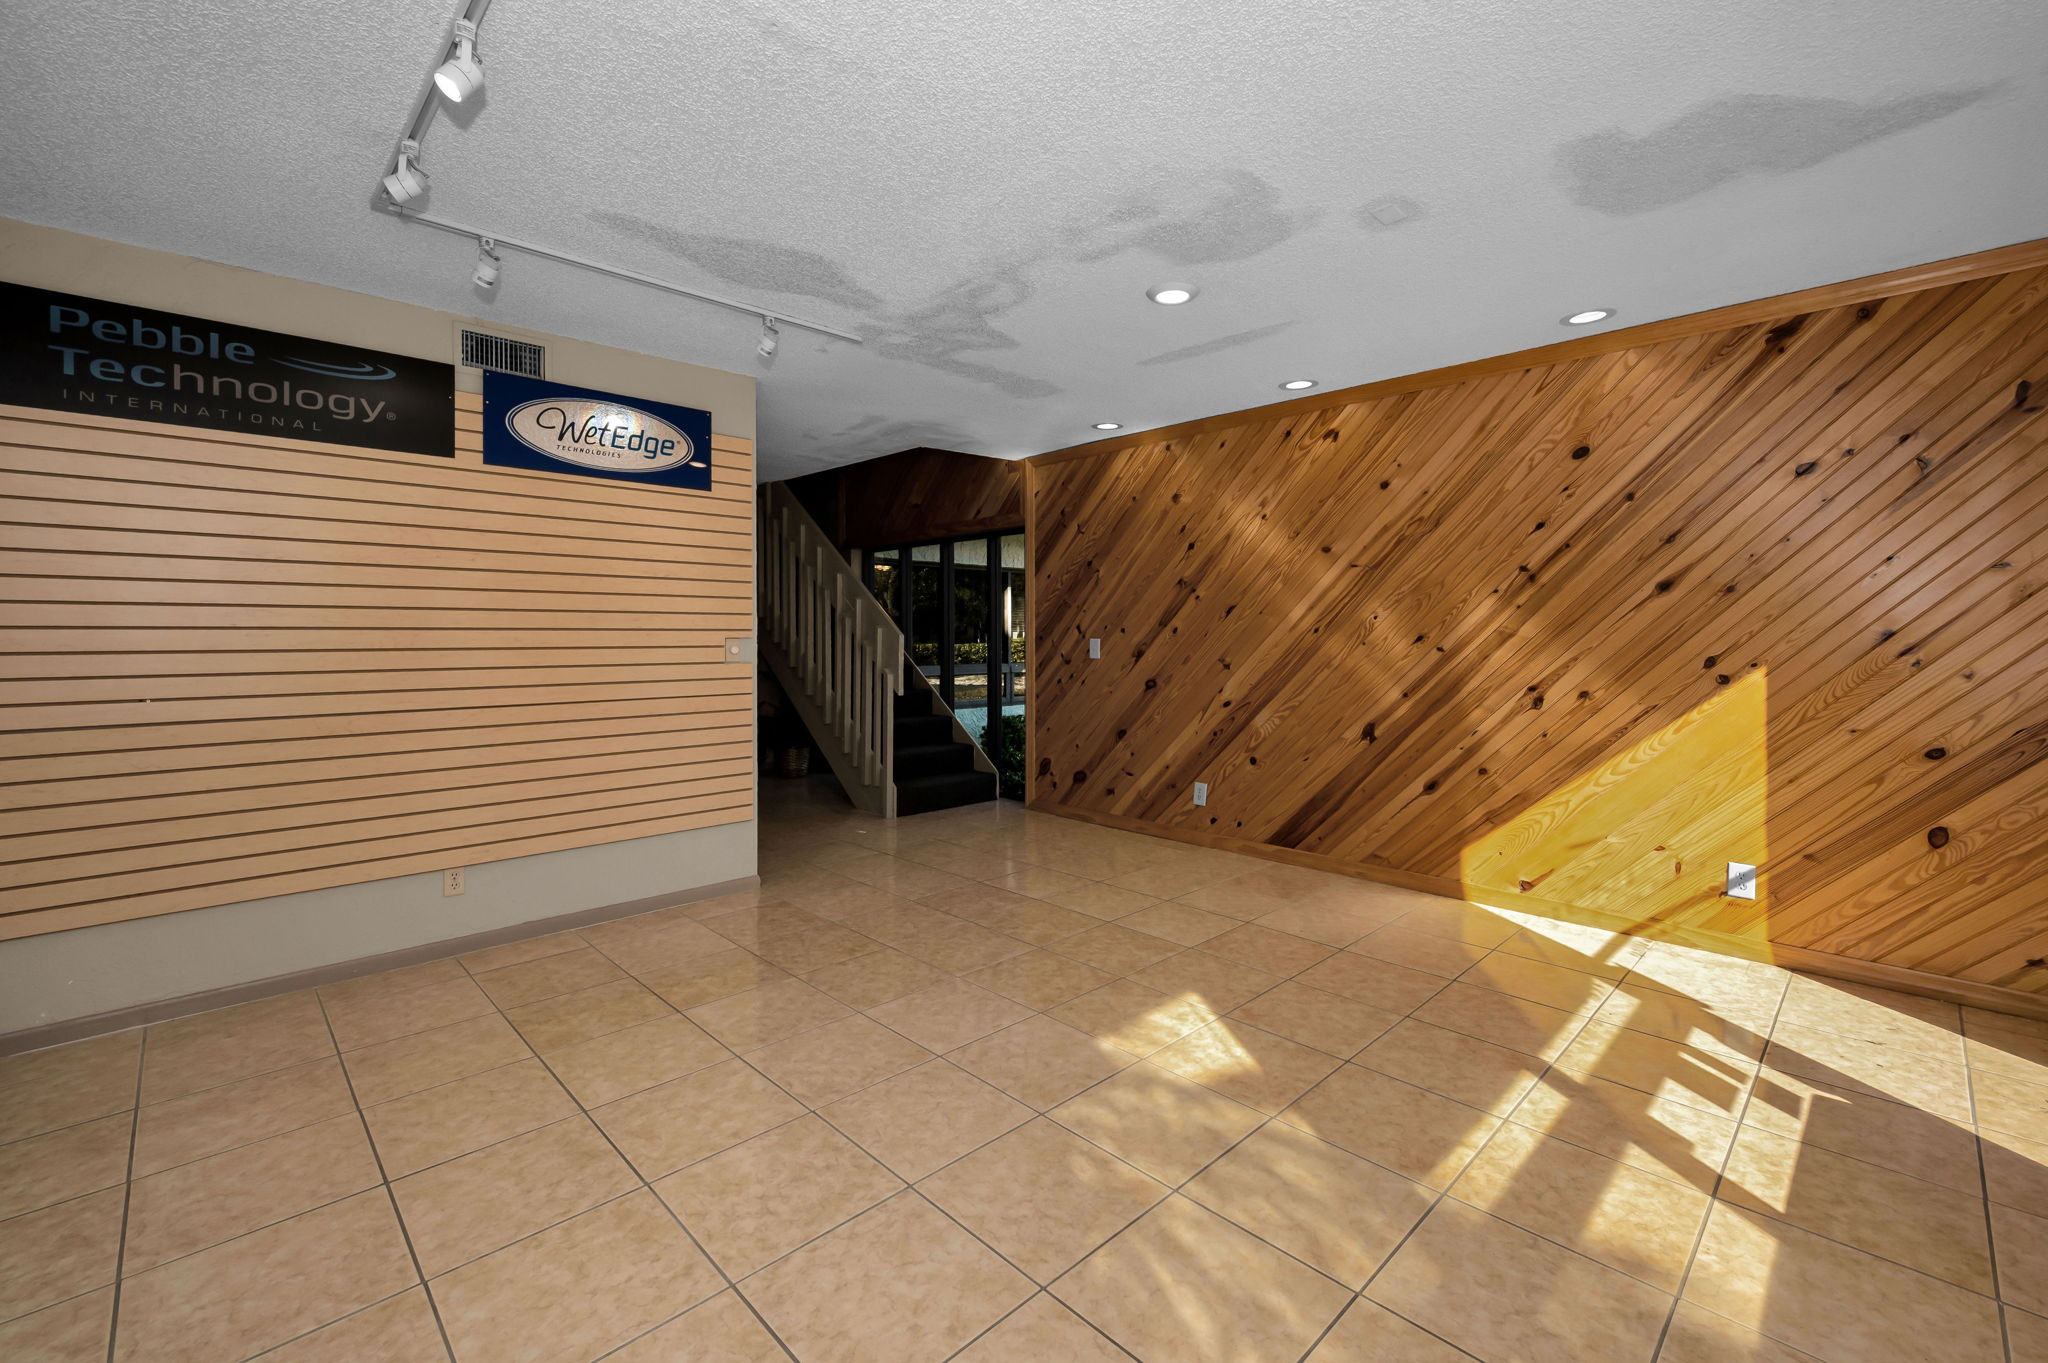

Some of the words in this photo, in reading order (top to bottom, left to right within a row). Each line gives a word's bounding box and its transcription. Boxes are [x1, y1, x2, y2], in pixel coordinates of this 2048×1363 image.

[48, 304, 256, 365] Pebble
[62, 388, 322, 432] INTERNATIONAL
[556, 445, 621, 458] TECHNOLOGIES
